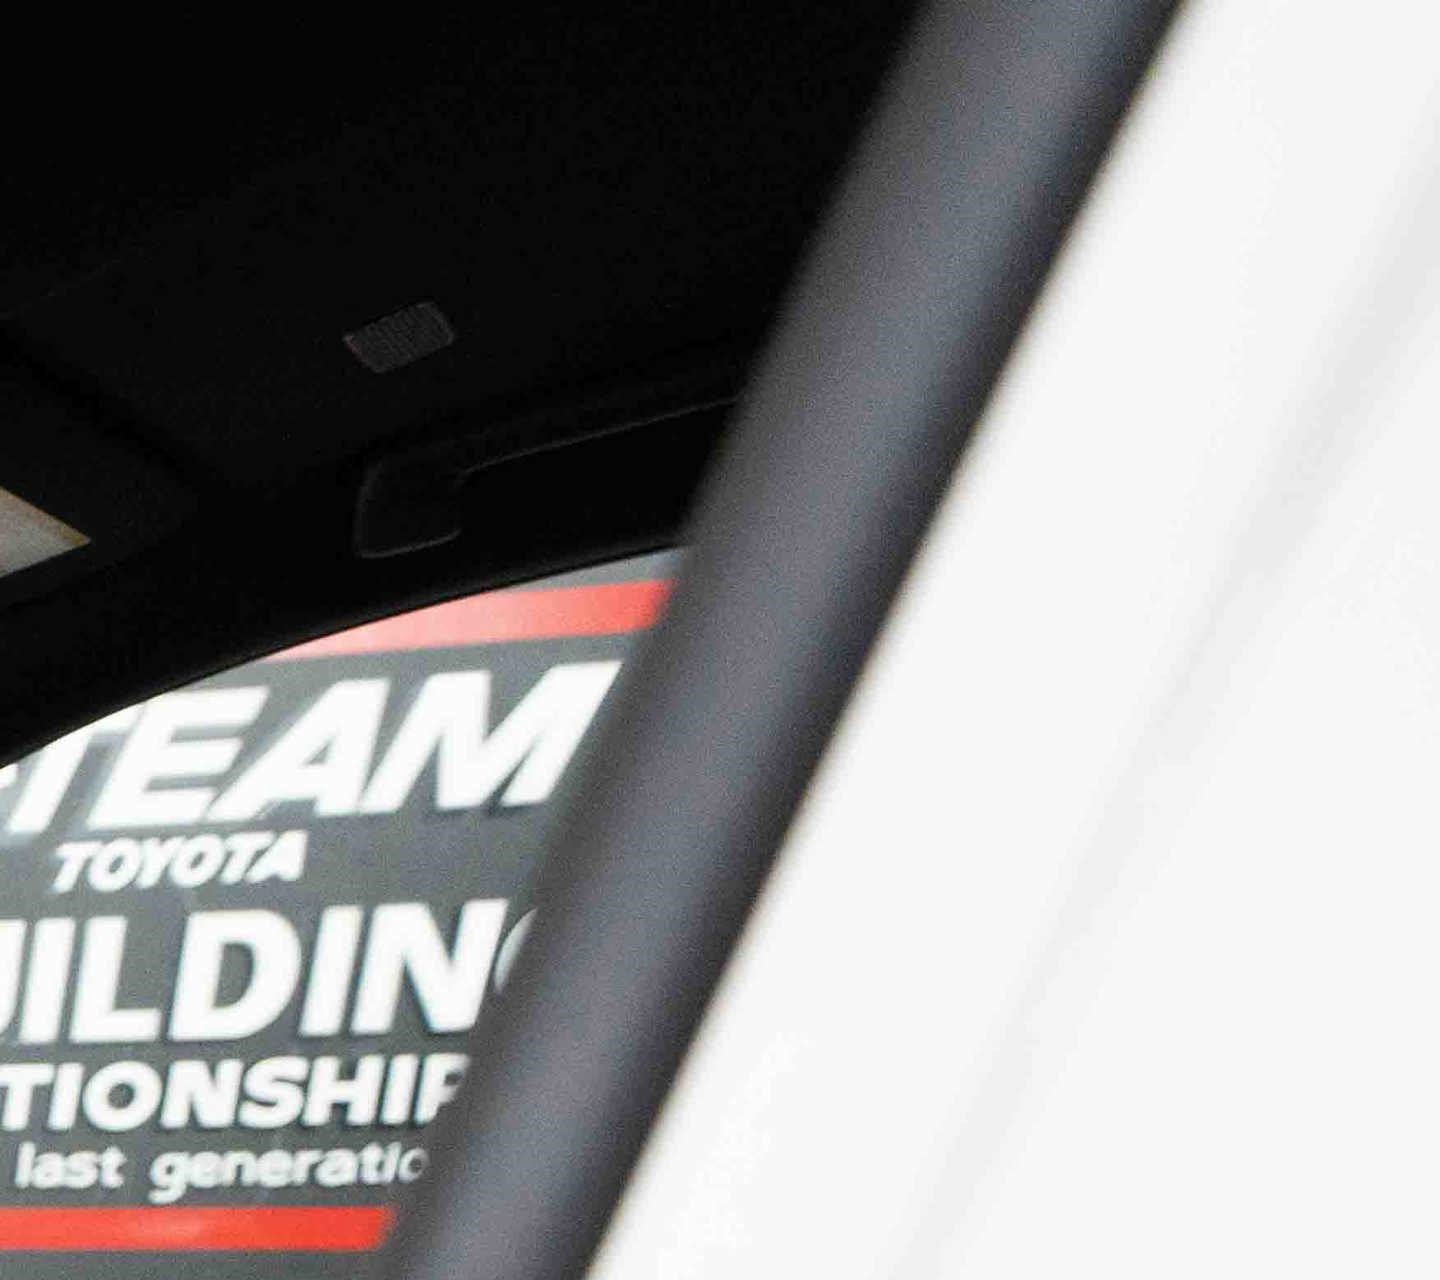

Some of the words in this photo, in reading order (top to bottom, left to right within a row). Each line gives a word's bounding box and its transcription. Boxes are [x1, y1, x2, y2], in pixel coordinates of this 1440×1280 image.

[7, 661, 622, 833] TEAM
[52, 830, 308, 894] TOYOTA
[14, 1140, 127, 1189] last
